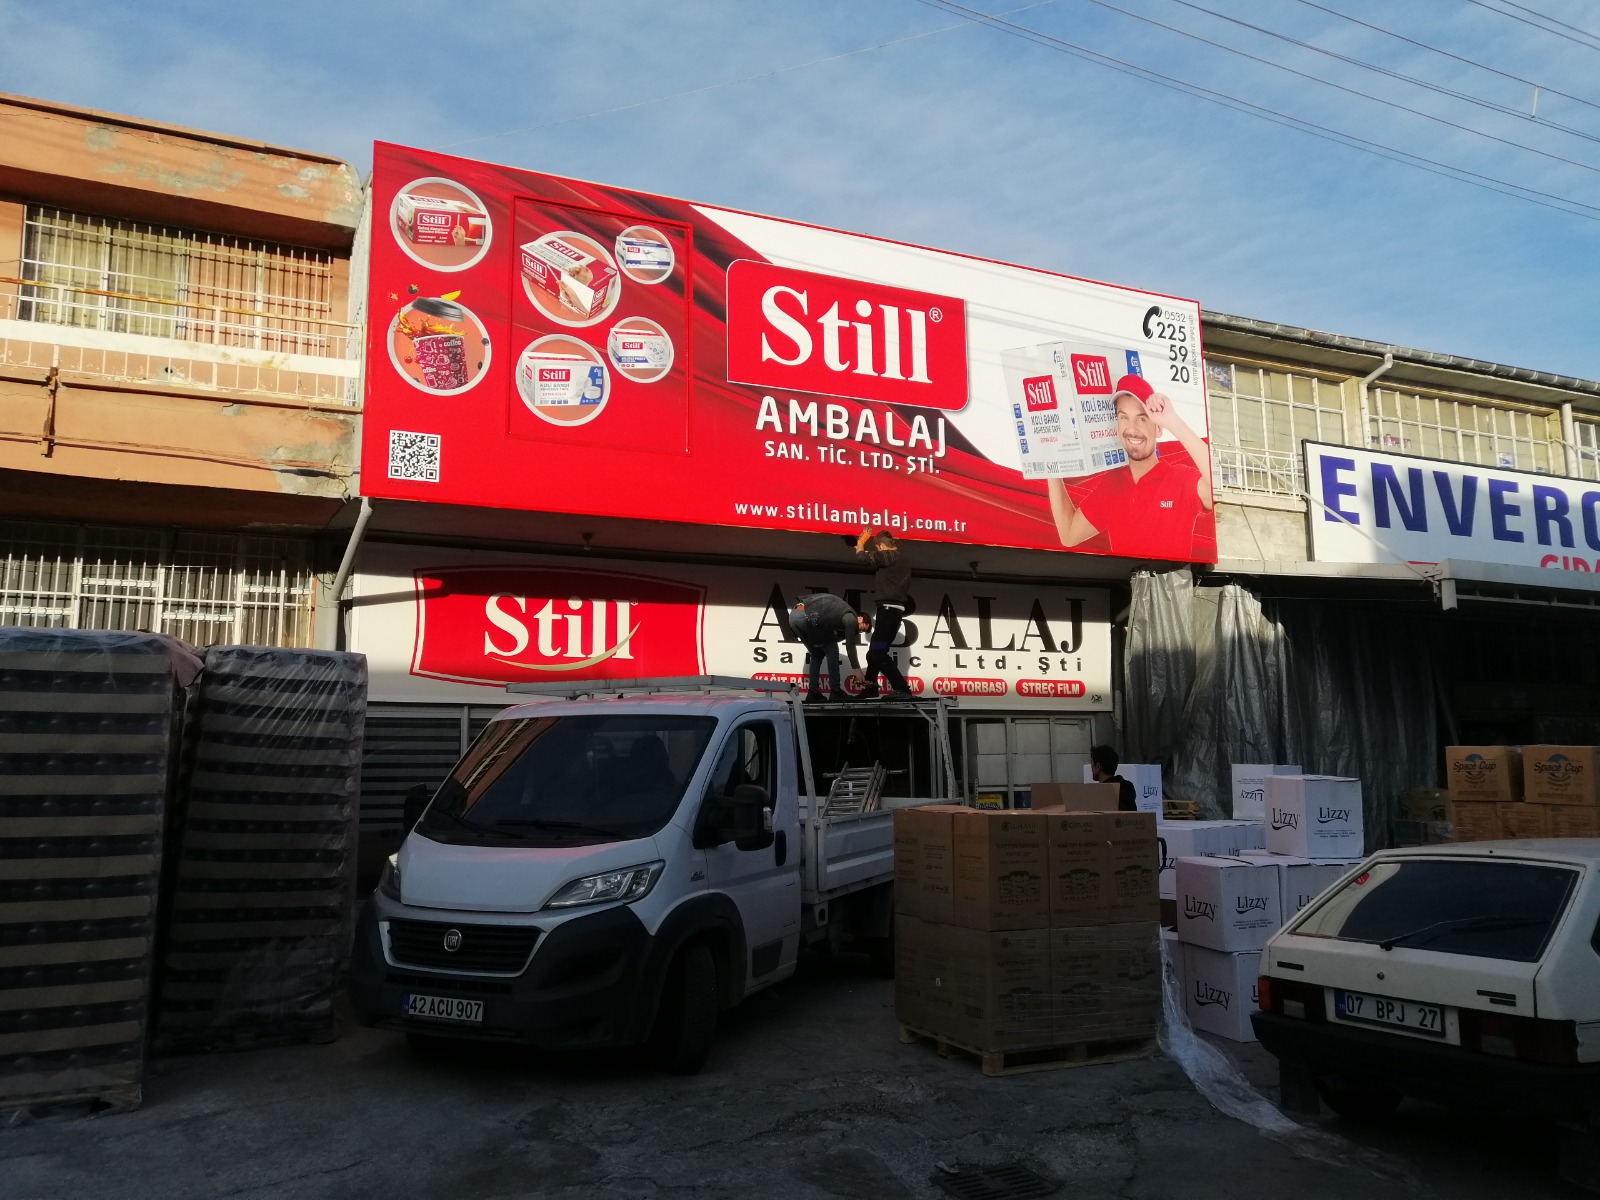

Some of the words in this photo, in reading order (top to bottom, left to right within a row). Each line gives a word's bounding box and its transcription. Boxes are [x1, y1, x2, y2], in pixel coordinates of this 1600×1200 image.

[1164, 310, 1187, 323] 0532
[1156, 321, 1187, 343] 225
[1169, 344, 1188, 363] 59
[542, 369, 567, 380] Still
[1076, 359, 1108, 387] Still
[1169, 364, 1190, 384] 20
[755, 395, 946, 457] AMBALAJ
[765, 440, 810, 461] SAN.
[817, 444, 852, 465] TİC.
[860, 450, 899, 470] LTD.
[907, 454, 940, 475] ŞTİ.
[735, 502, 967, 532] www.stillambalaj.com.tr
[485, 591, 634, 660] Still
[748, 582, 1087, 654] AALAJ
[955, 653, 1022, 670] Ltd.
[1038, 656, 1082, 675] Şti
[935, 677, 957, 694] ÇÖP
[961, 681, 1006, 694] TORBASI
[1022, 682, 1055, 697] STREÇ
[1453, 762, 1477, 773] Space
[1479, 760, 1497, 772] Cup
[1533, 762, 1561, 774] Space
[1563, 762, 1583, 774] Cup
[1272, 807, 1299, 830] Lizzy
[1319, 807, 1351, 823] Lizzy
[1185, 894, 1216, 921] Lizzy
[1237, 896, 1268, 911] Lizzy
[1196, 980, 1231, 1010] Lizzy
[409, 996, 427, 1014] 42
[428, 998, 454, 1017] ACU
[456, 1001, 482, 1020] 907
[1346, 994, 1363, 1015] 07
[1375, 1000, 1405, 1023] BPJ
[1418, 1007, 1438, 1029] 27
